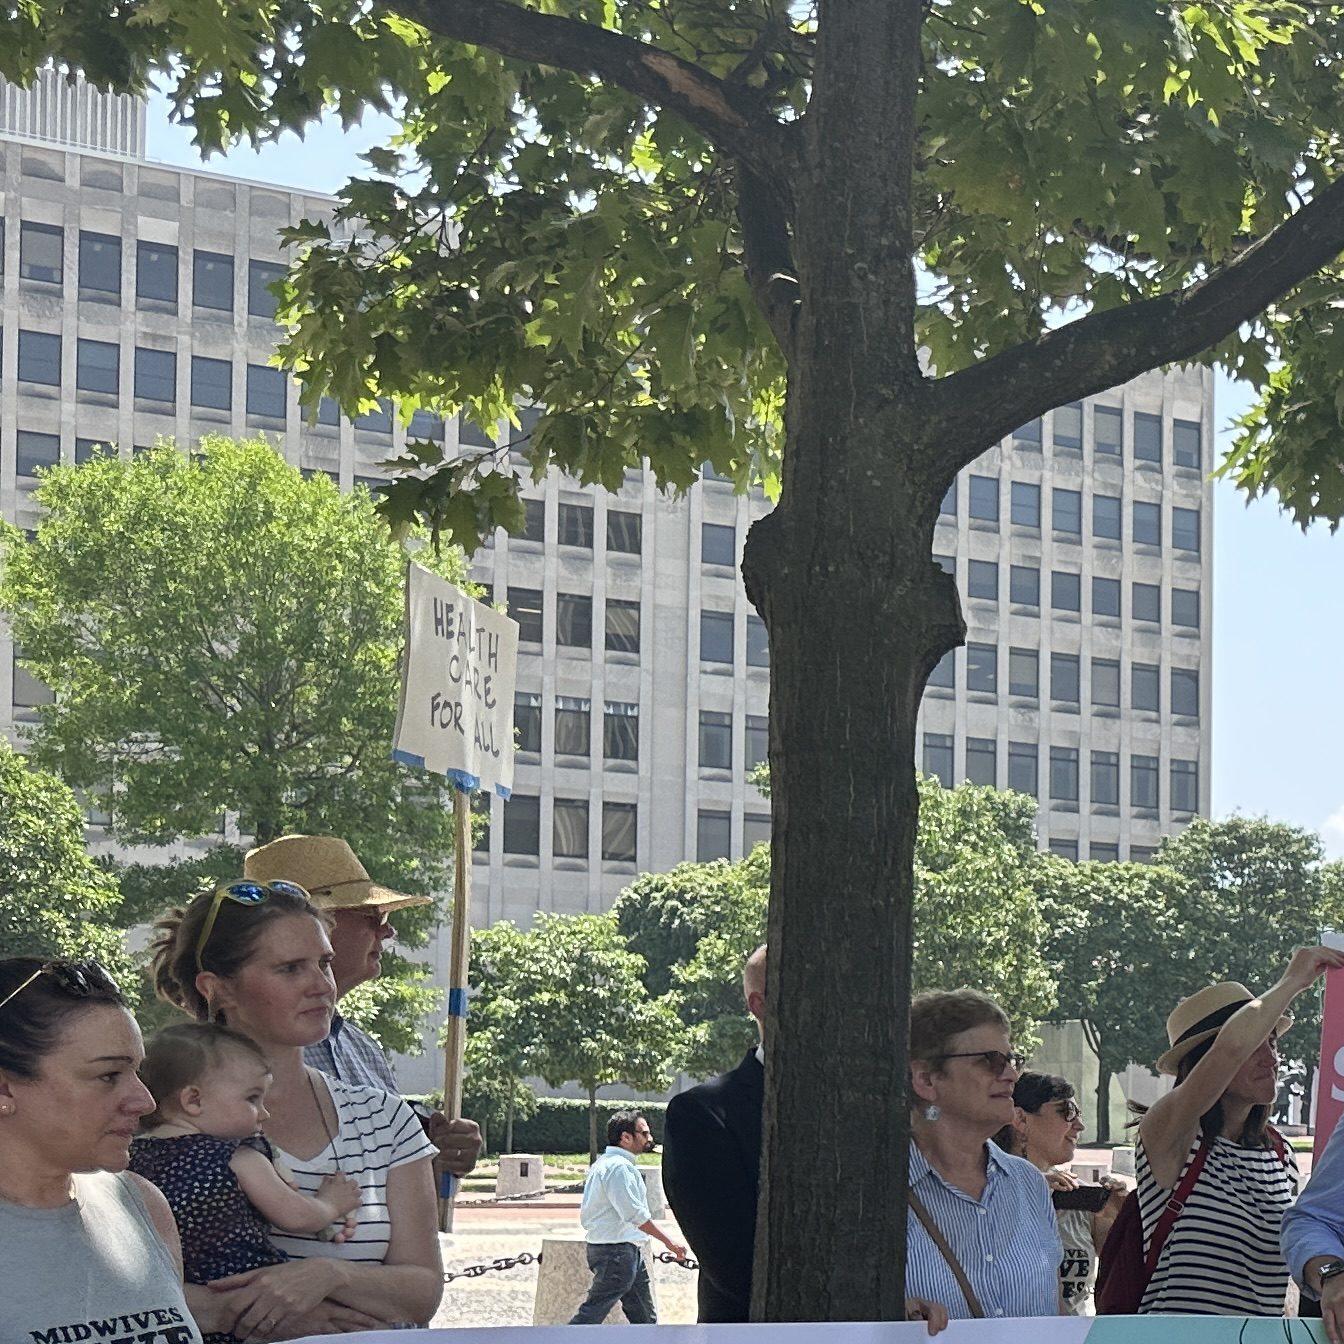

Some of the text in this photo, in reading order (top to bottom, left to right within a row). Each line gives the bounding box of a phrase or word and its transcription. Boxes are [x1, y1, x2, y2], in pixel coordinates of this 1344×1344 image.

[434, 597, 499, 673] HEALTH
[449, 654, 496, 709] CARE
[431, 692, 500, 758] FOR ALL
